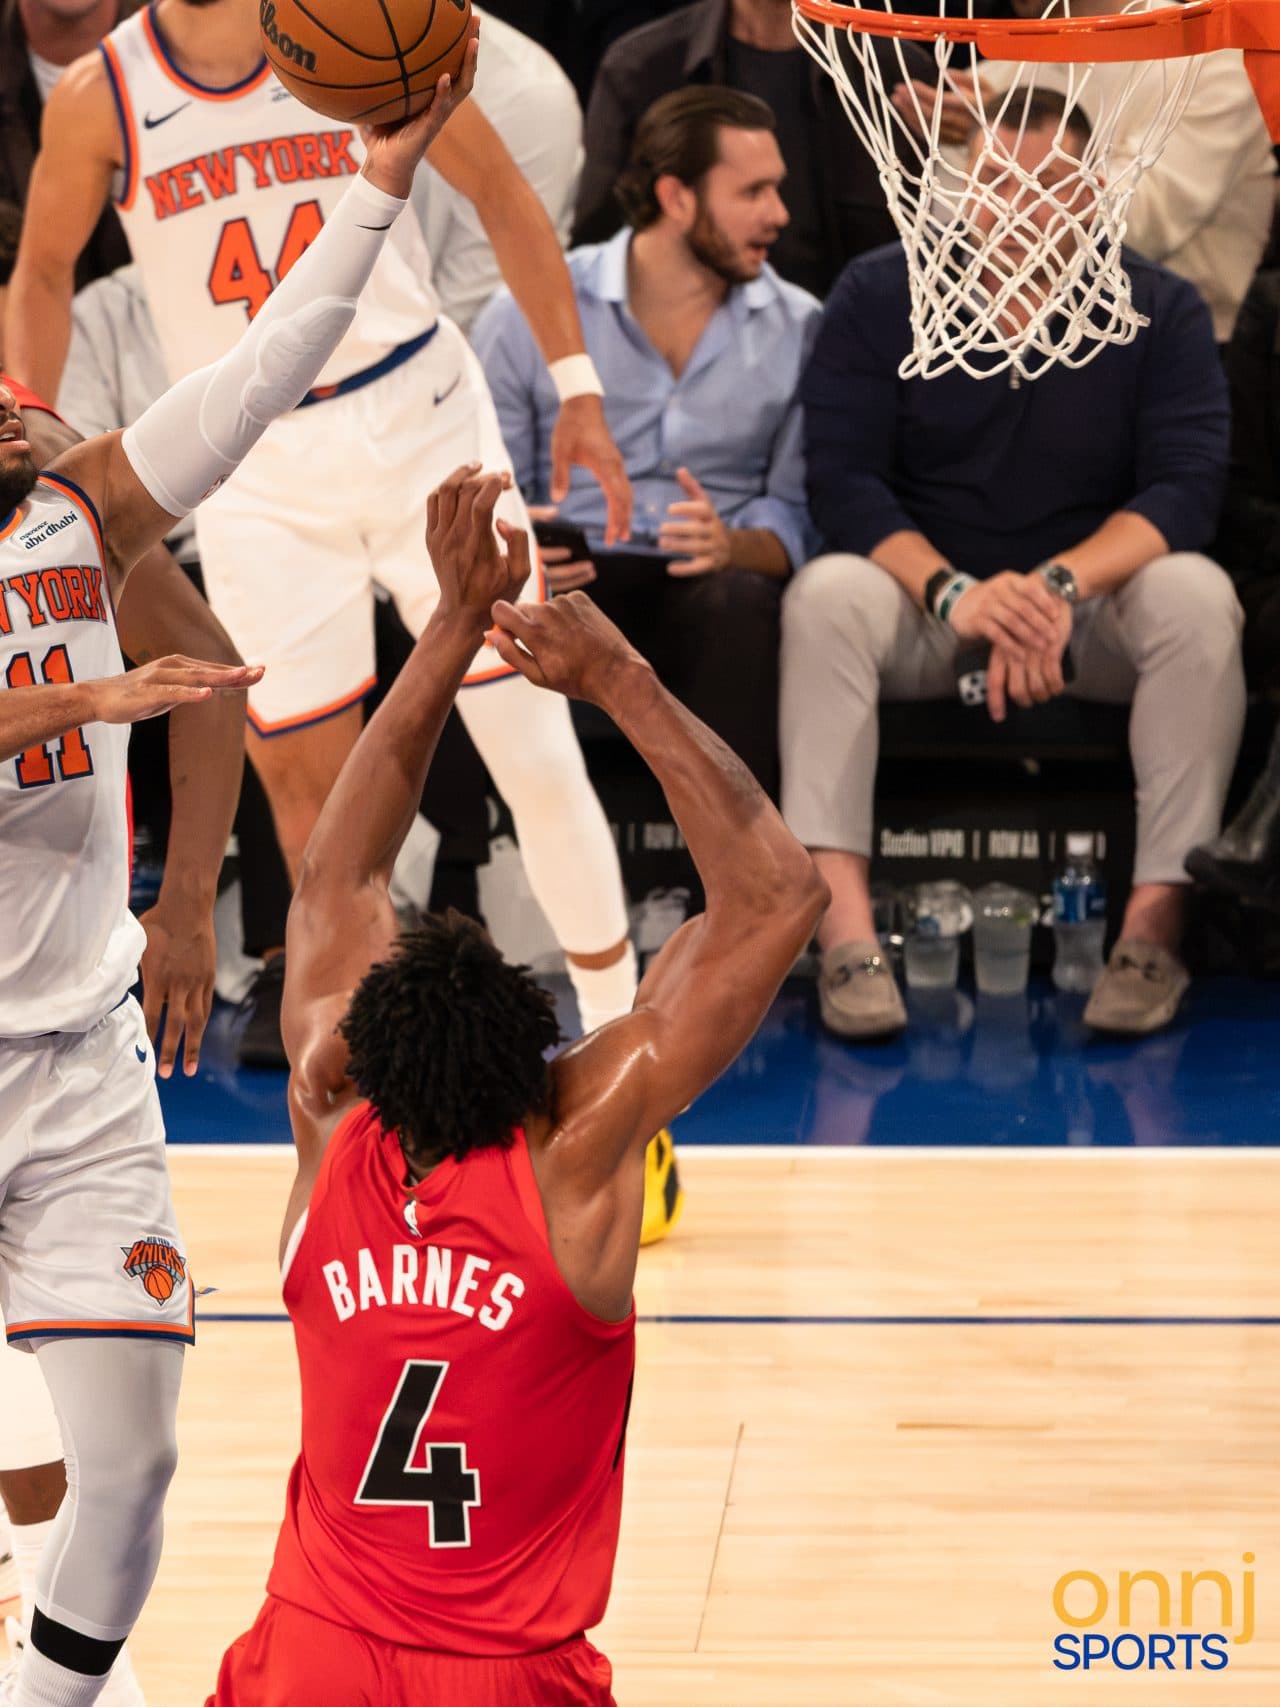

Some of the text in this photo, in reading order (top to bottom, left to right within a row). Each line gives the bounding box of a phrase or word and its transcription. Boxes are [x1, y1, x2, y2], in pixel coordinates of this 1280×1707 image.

[260, 0, 318, 74] lson
[144, 129, 361, 221] NEW YORK
[24, 510, 78, 550] abu dhabi
[6, 564, 108, 630] YORK
[5, 643, 94, 789] 11
[123, 1239, 186, 1280] KNICKS
[322, 1243, 526, 1332] BARNES
[353, 1358, 482, 1549] 4
